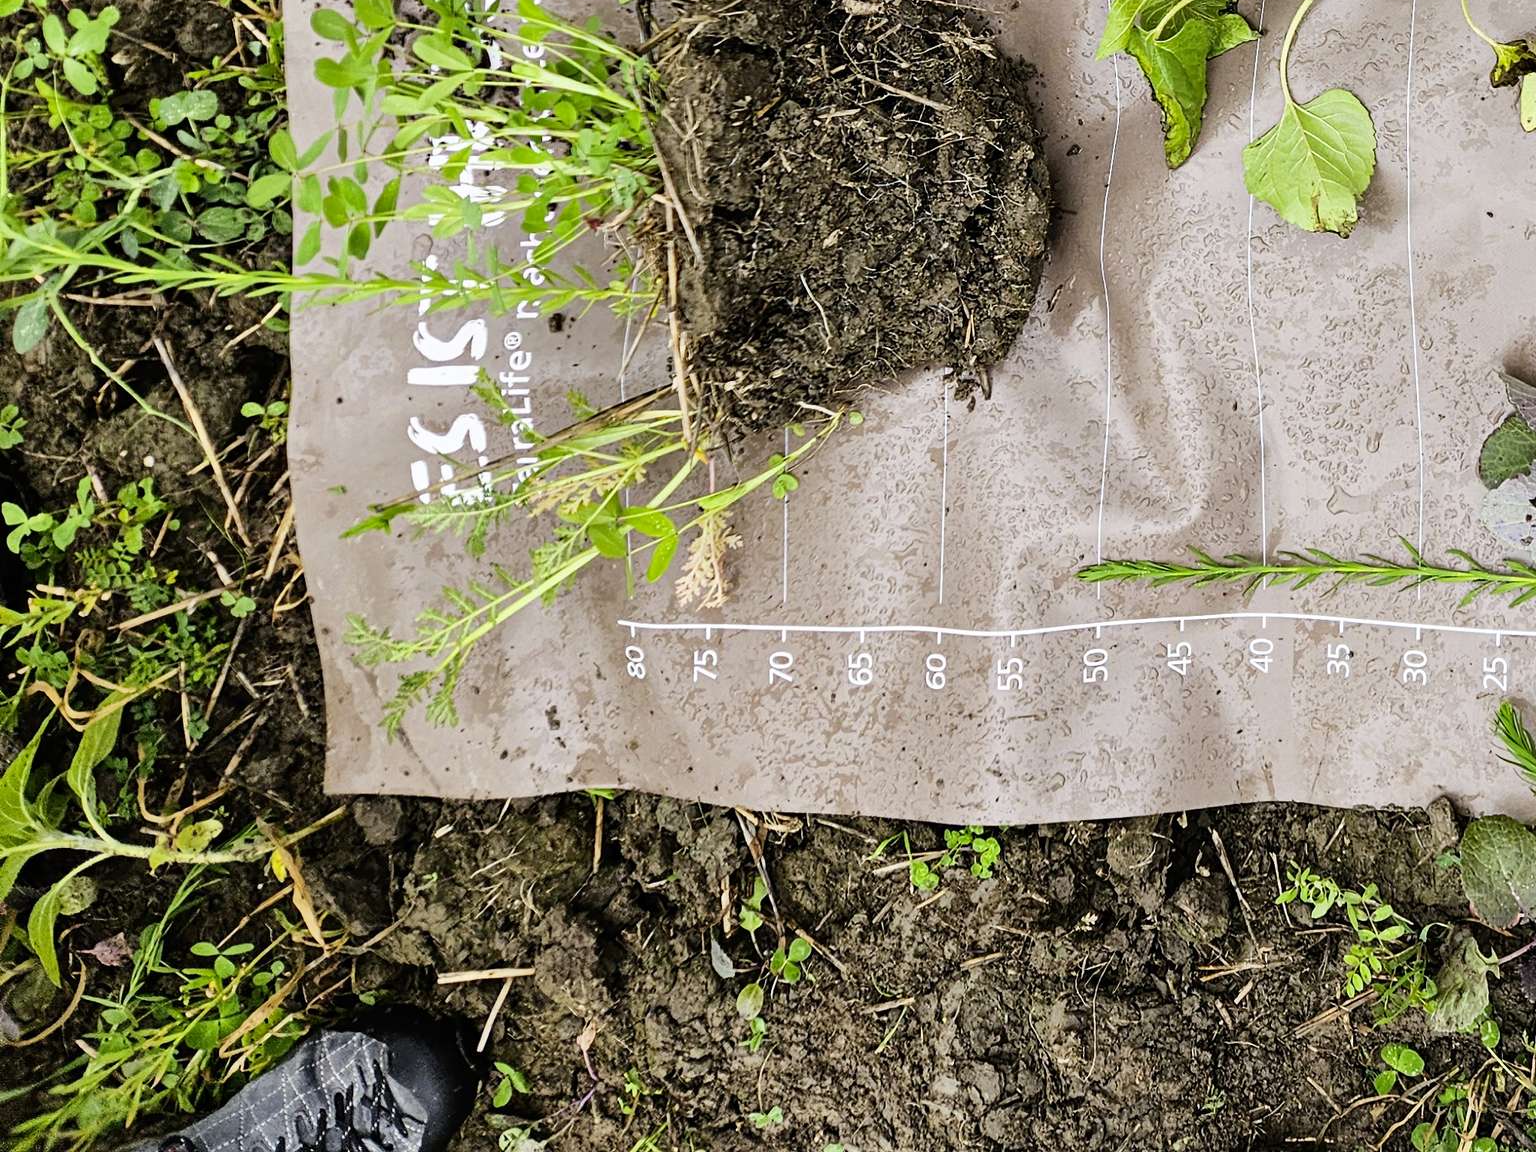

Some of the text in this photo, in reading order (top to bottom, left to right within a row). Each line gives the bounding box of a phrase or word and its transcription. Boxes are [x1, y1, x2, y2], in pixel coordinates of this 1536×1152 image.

[407, 413, 492, 507] ES
[625, 645, 646, 679] 80
[693, 650, 718, 682] 75
[769, 651, 794, 684] 70
[848, 652, 873, 686] 65
[925, 653, 947, 690] 60
[1083, 648, 1108, 683] 50
[1167, 641, 1192, 675] 45
[1249, 638, 1274, 673] 40
[1326, 643, 1350, 678] 35
[1402, 650, 1428, 686] 30
[997, 657, 1024, 691] 55
[1482, 657, 1508, 692] 25
